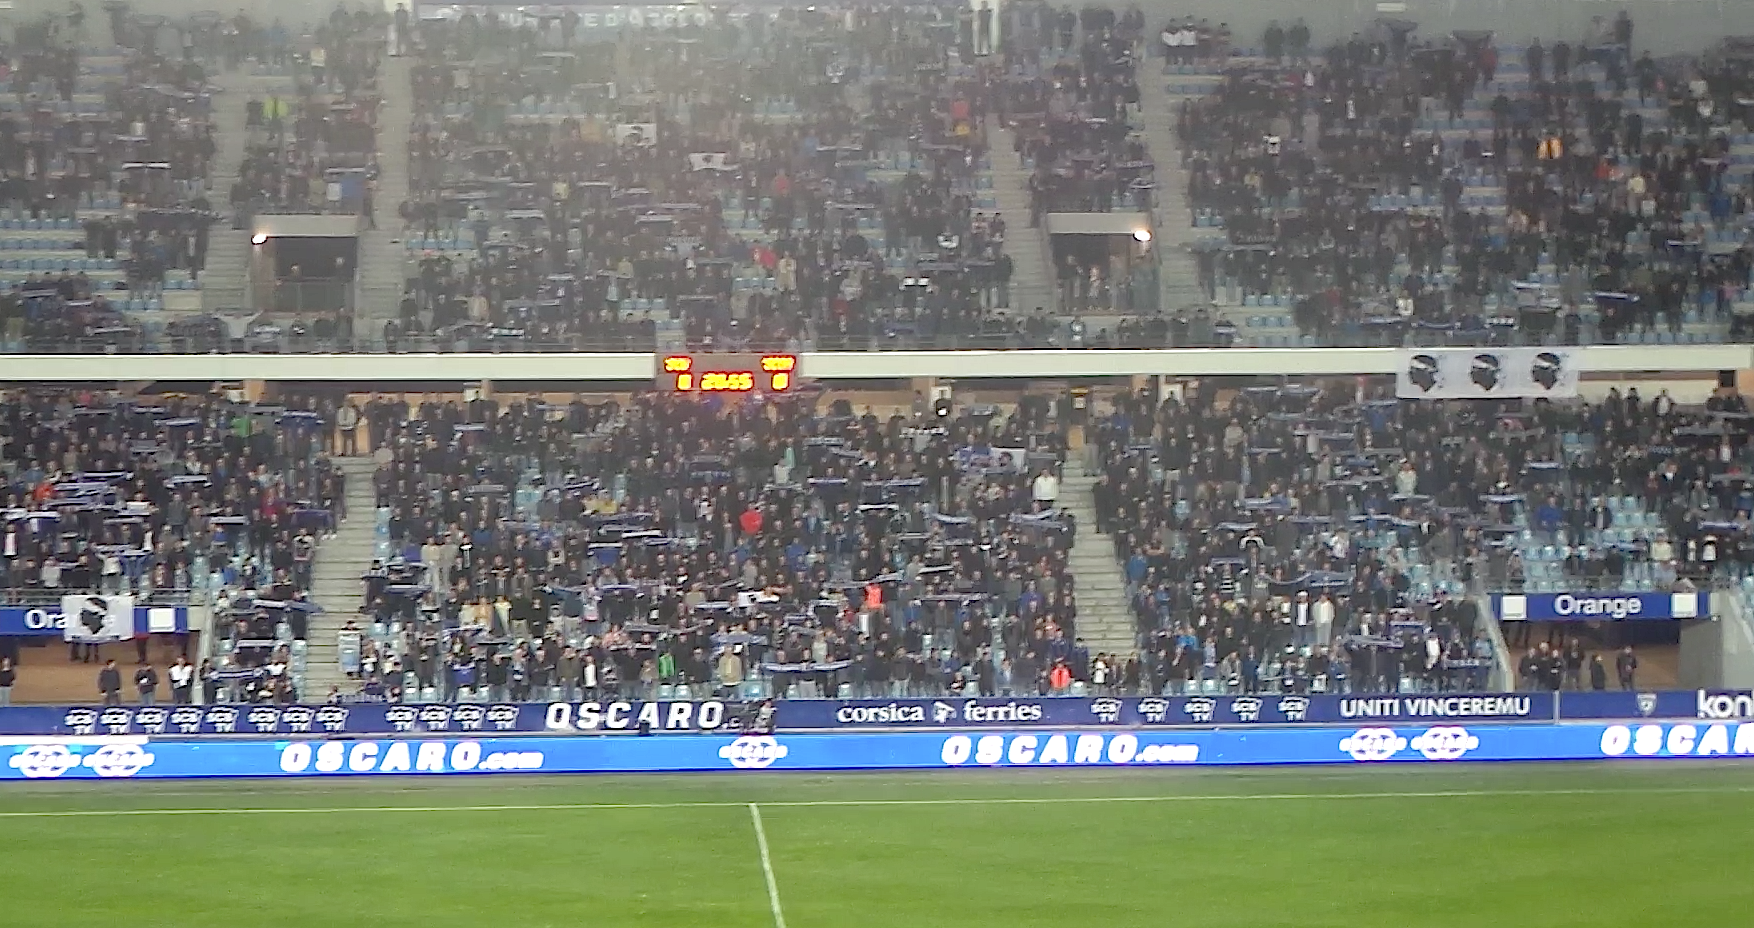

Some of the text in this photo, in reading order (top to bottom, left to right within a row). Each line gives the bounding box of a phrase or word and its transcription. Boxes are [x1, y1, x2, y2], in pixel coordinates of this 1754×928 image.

[1554, 594, 1642, 619] Orange
[837, 700, 1043, 722] corsica ferries
[1340, 697, 1531, 717] UNITI VINCEREMU
[1697, 689, 1754, 718] kon
[280, 741, 544, 772] OSCARO.com
[941, 735, 1199, 764] OSCARO.com
